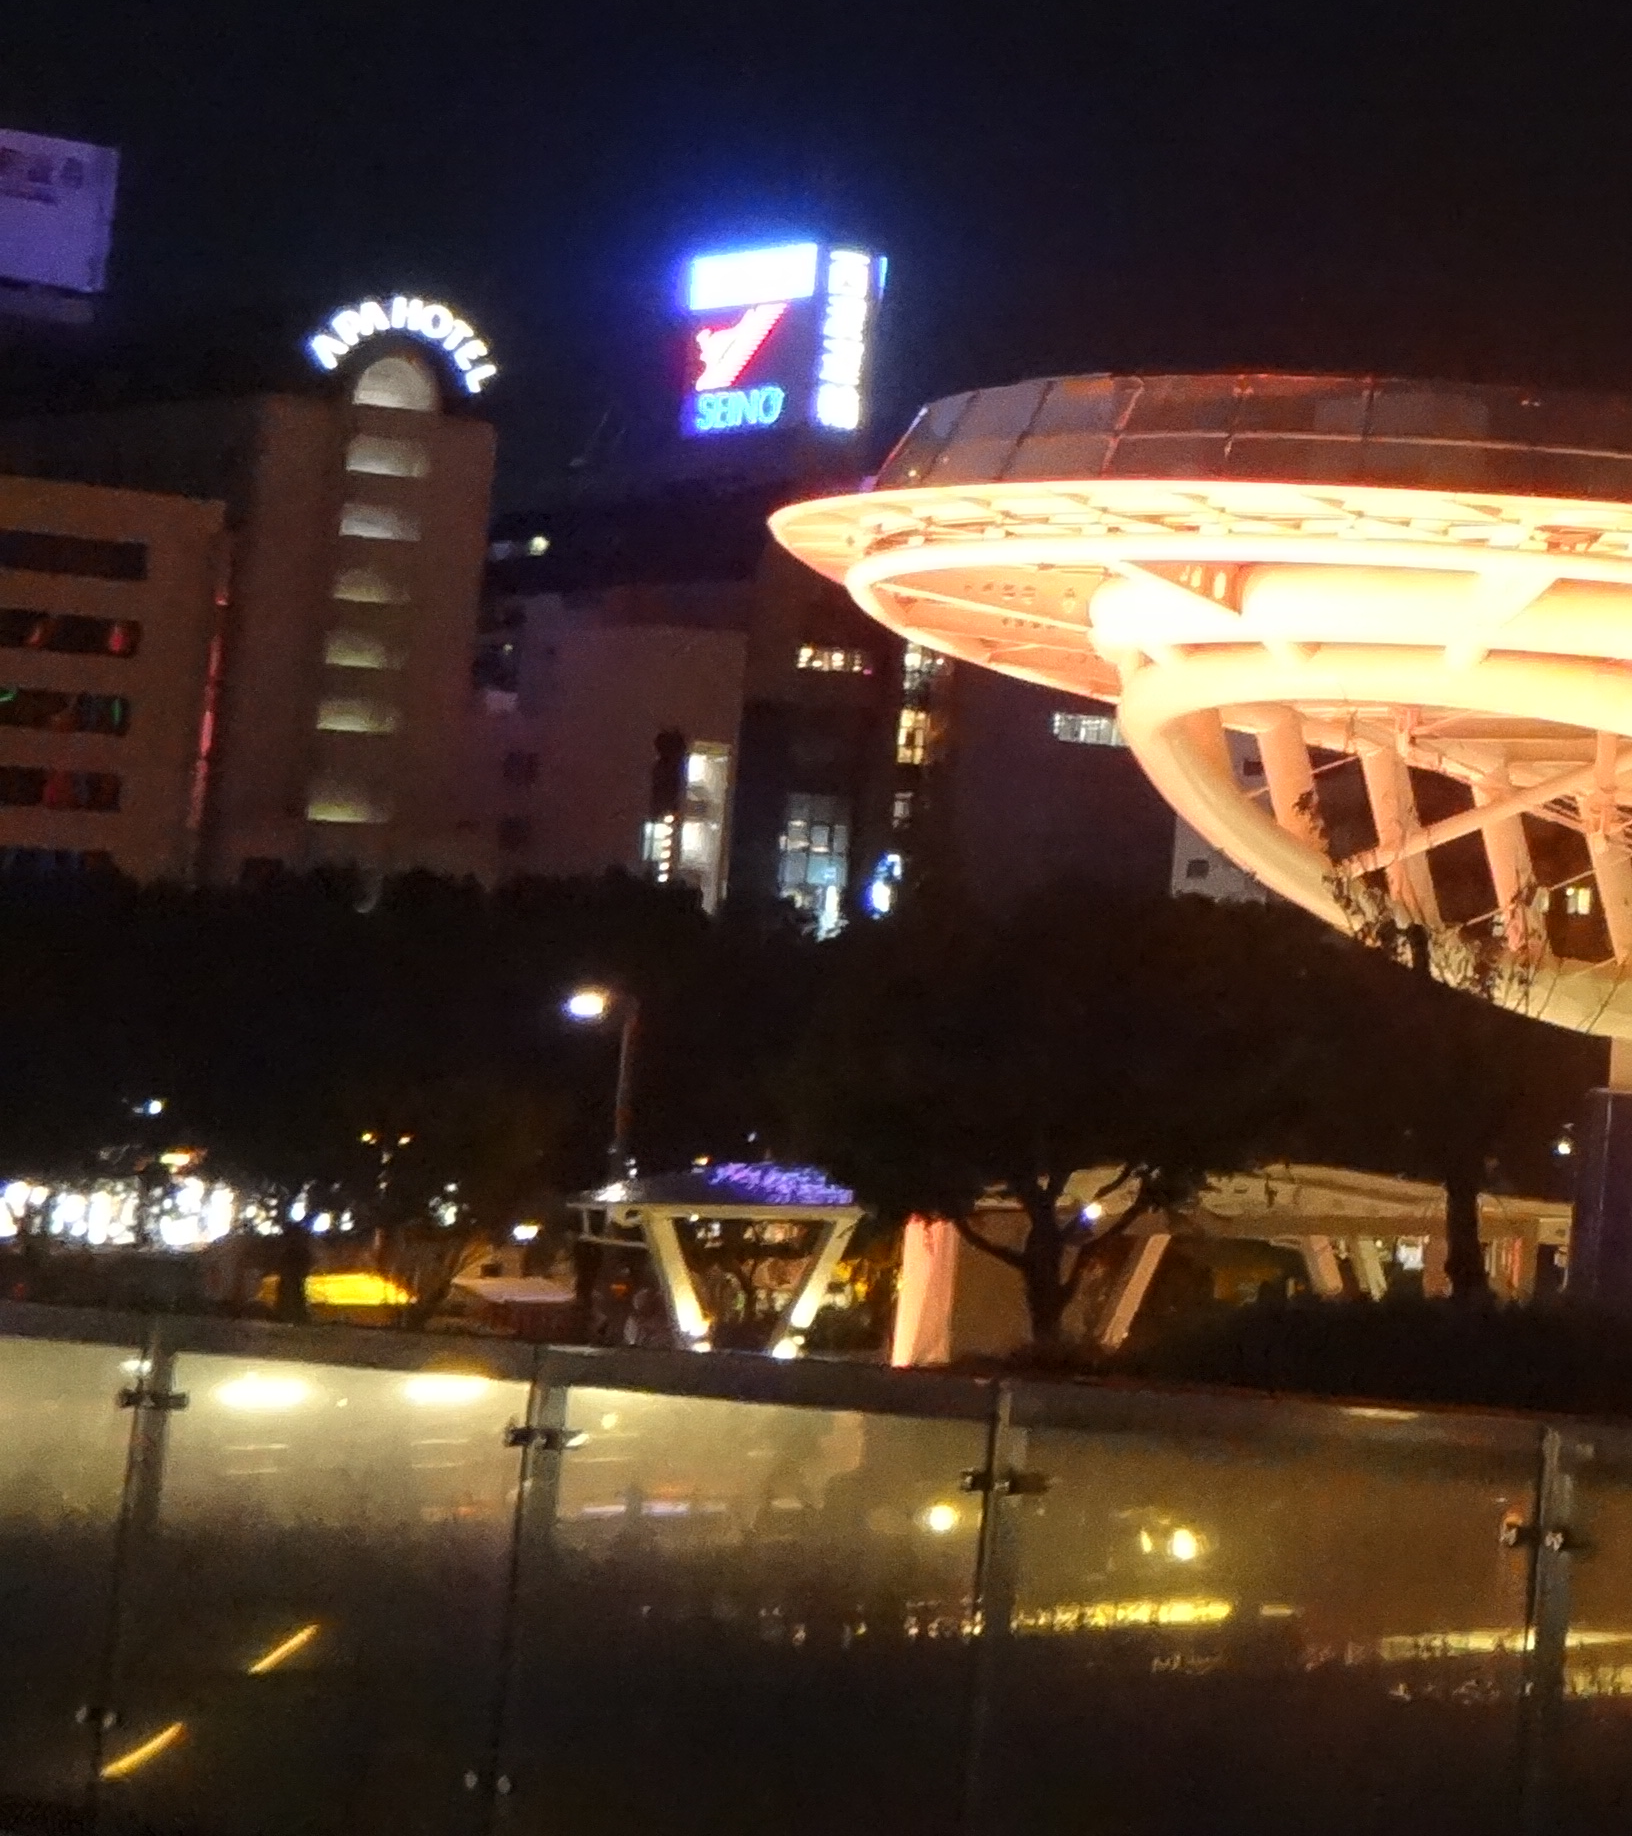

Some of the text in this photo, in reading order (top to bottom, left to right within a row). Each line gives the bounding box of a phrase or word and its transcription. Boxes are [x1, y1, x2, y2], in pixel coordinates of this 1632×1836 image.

[310, 296, 497, 393] APA HOTEL
[696, 386, 785, 430] SEINO
